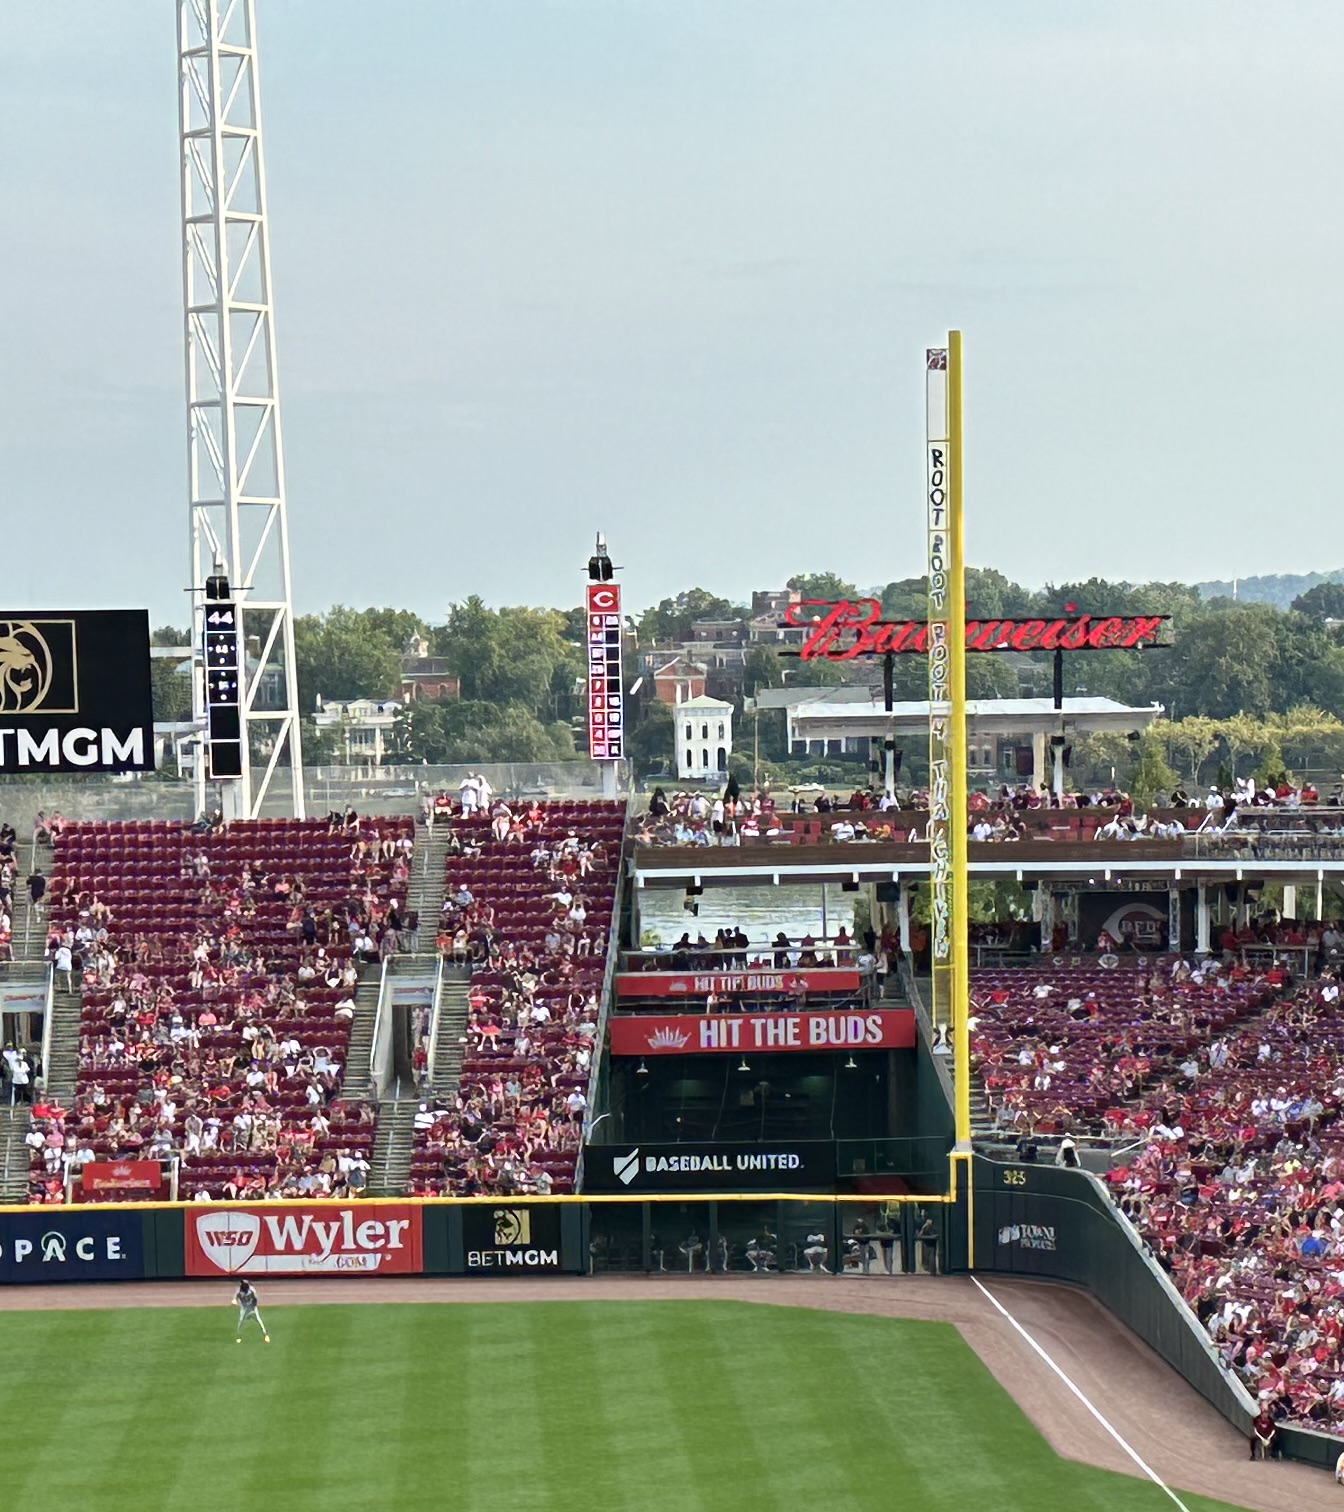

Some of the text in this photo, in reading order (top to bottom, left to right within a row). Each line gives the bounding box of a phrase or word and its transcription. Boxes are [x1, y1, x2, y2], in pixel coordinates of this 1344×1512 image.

[207, 610, 234, 625] 44
[699, 1014, 884, 1048] HIT THE BUDS
[645, 1154, 733, 1172] BASEBALL
[263, 1210, 410, 1261] Wyler
[468, 1249, 558, 1268] BETMGM
